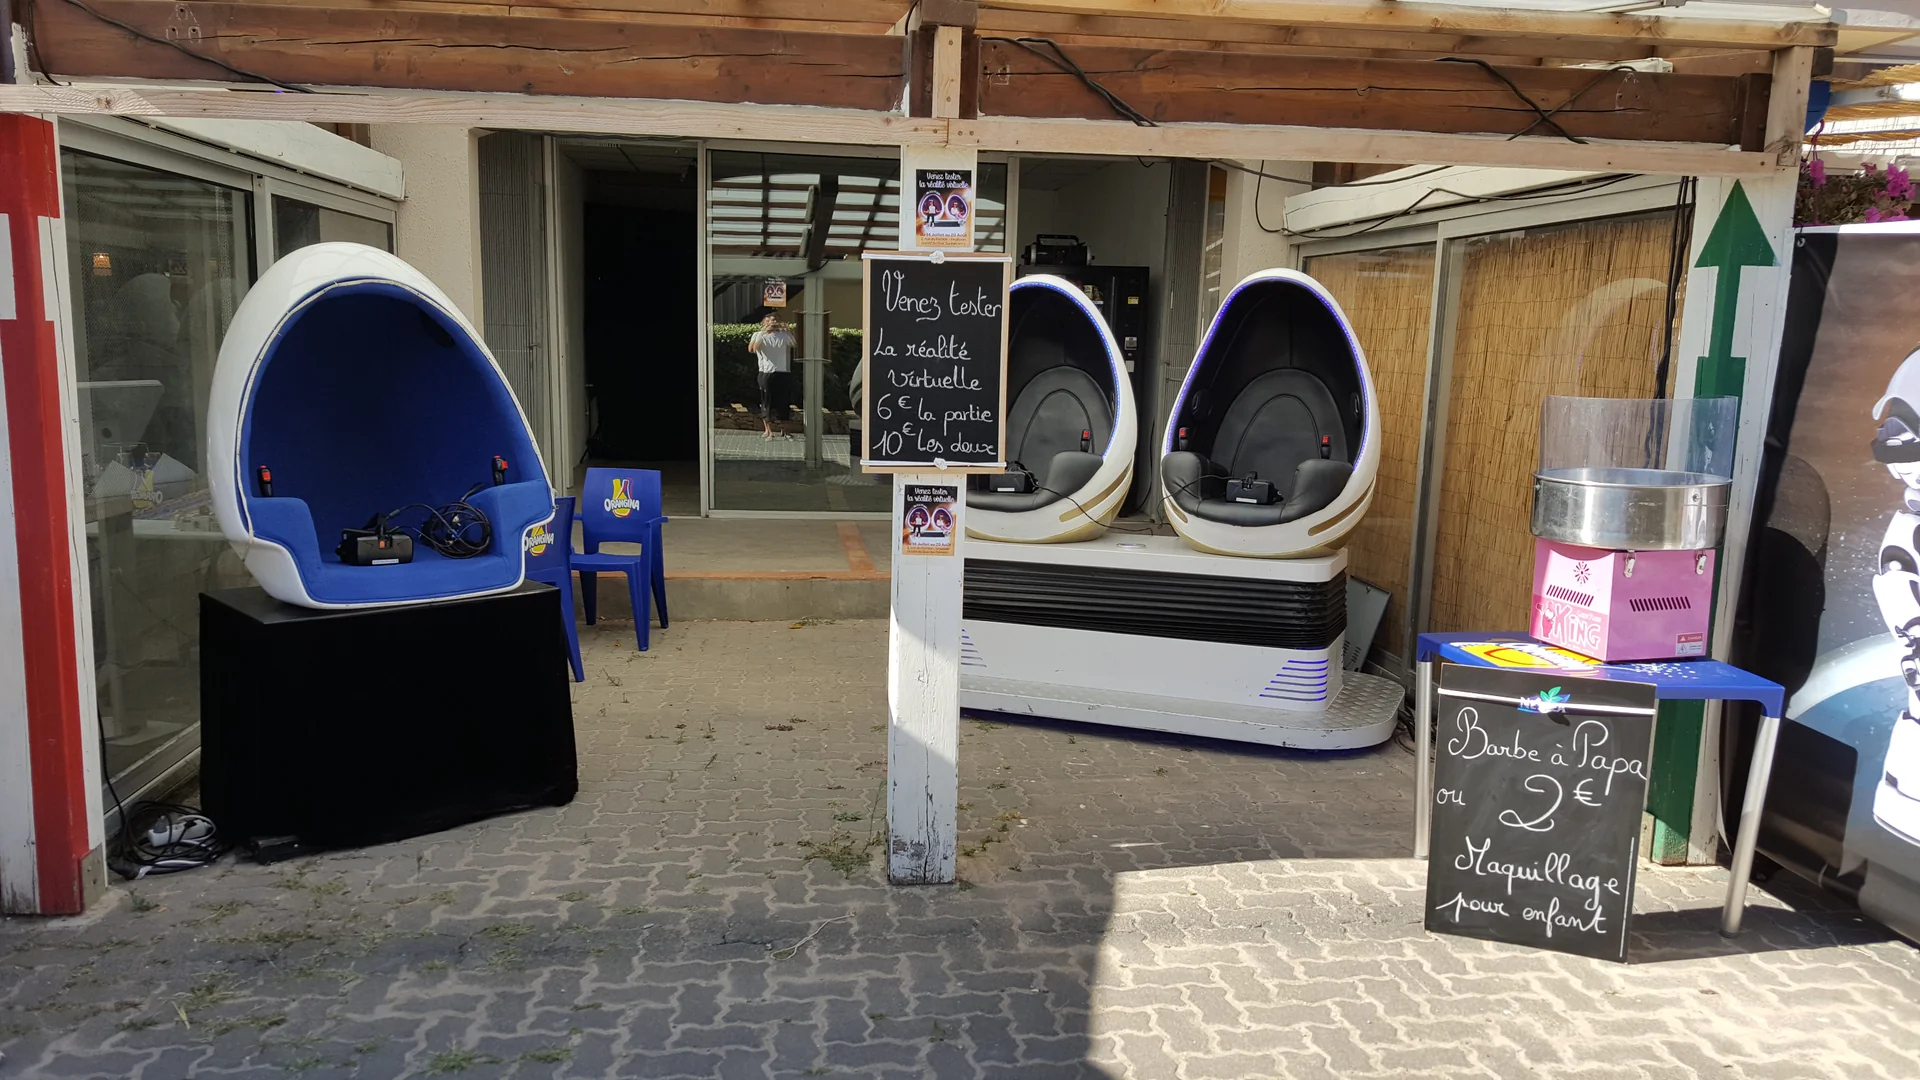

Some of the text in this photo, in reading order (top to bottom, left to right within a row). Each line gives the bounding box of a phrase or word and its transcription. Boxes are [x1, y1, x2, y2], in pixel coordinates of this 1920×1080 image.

[919, 180, 926, 188] la
[926, 180, 945, 188] réalité
[926, 172, 962, 180] Venez tester
[882, 269, 1002, 323] Venez tester
[873, 327, 972, 361] La réalité
[943, 404, 994, 436] partie
[950, 431, 997, 455] deux
[906, 494, 913, 502] la
[914, 487, 931, 495] Venez
[604, 498, 640, 512] ORANGINA
[1448, 706, 1648, 796] Barbe à Papa
[1436, 787, 1466, 806] ou
[1454, 836, 1621, 911] Maquillage
[1435, 891, 1607, 938] pour enfant
